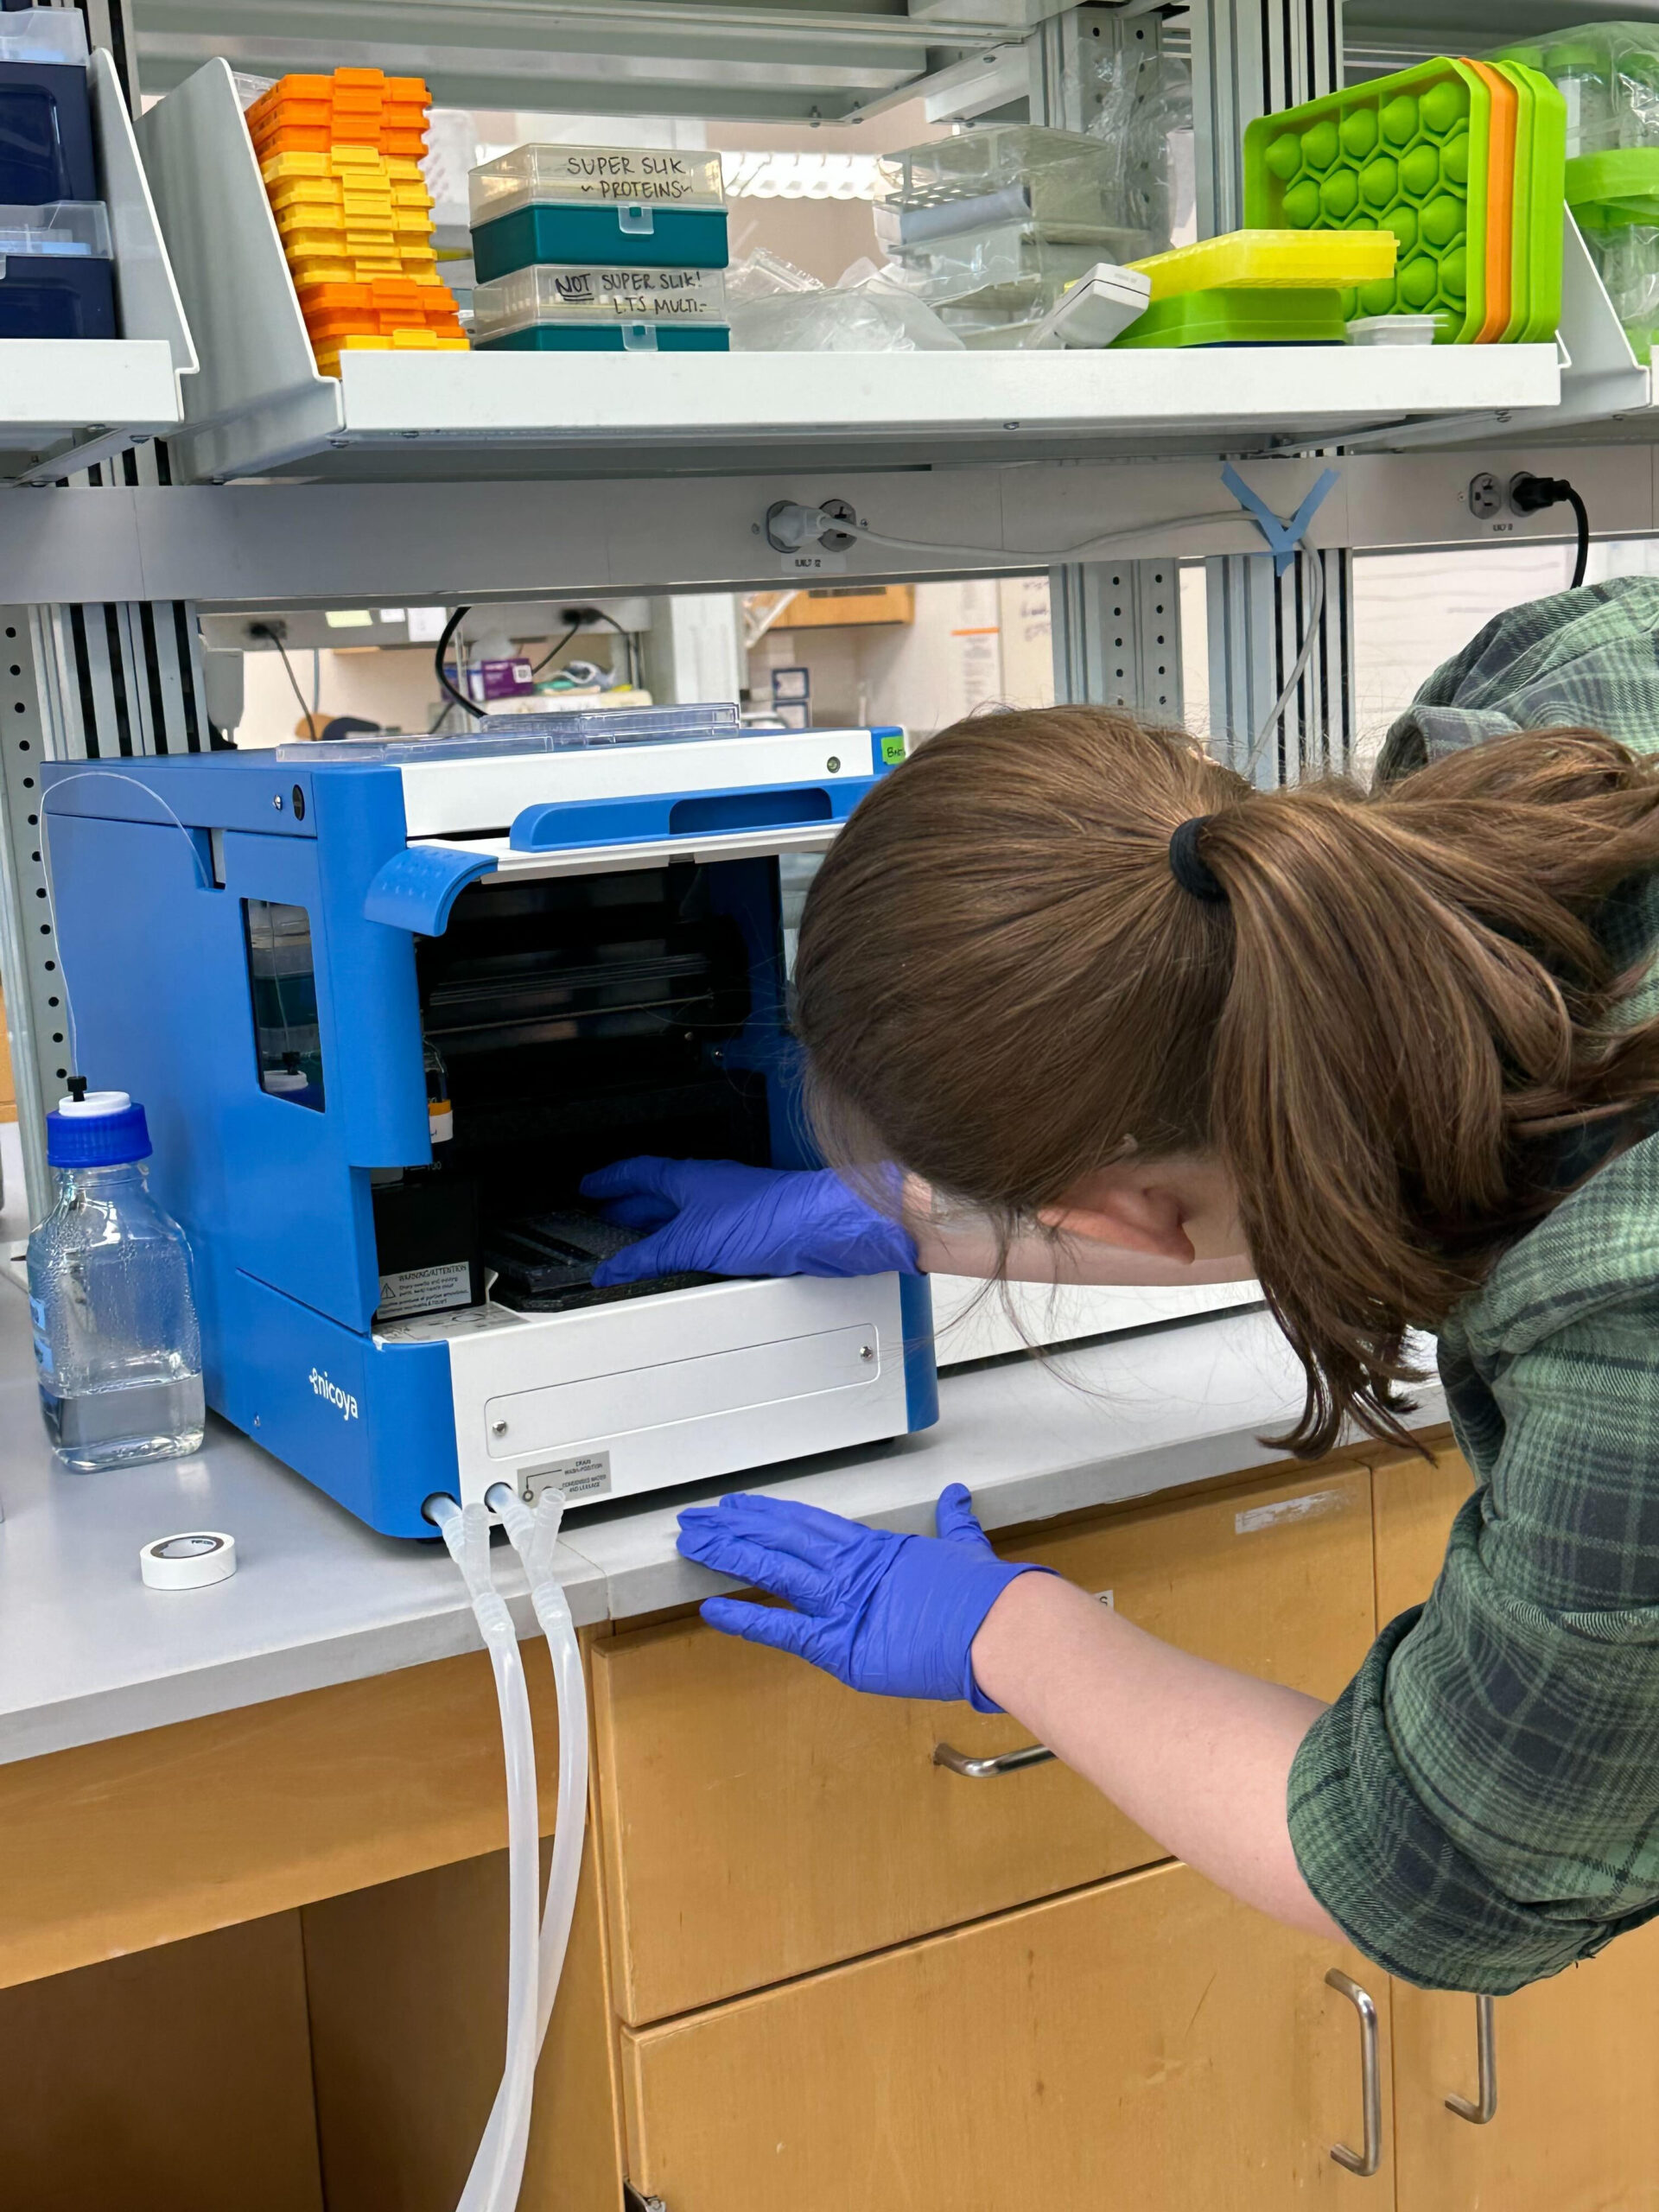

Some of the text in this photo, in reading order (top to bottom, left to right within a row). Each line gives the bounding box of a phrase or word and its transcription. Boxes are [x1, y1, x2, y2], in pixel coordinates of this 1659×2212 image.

[567, 156, 635, 175] SUPER
[555, 273, 592, 294] NOT
[602, 272, 656, 290] SUPER
[317, 1370, 359, 1421] nicoya
